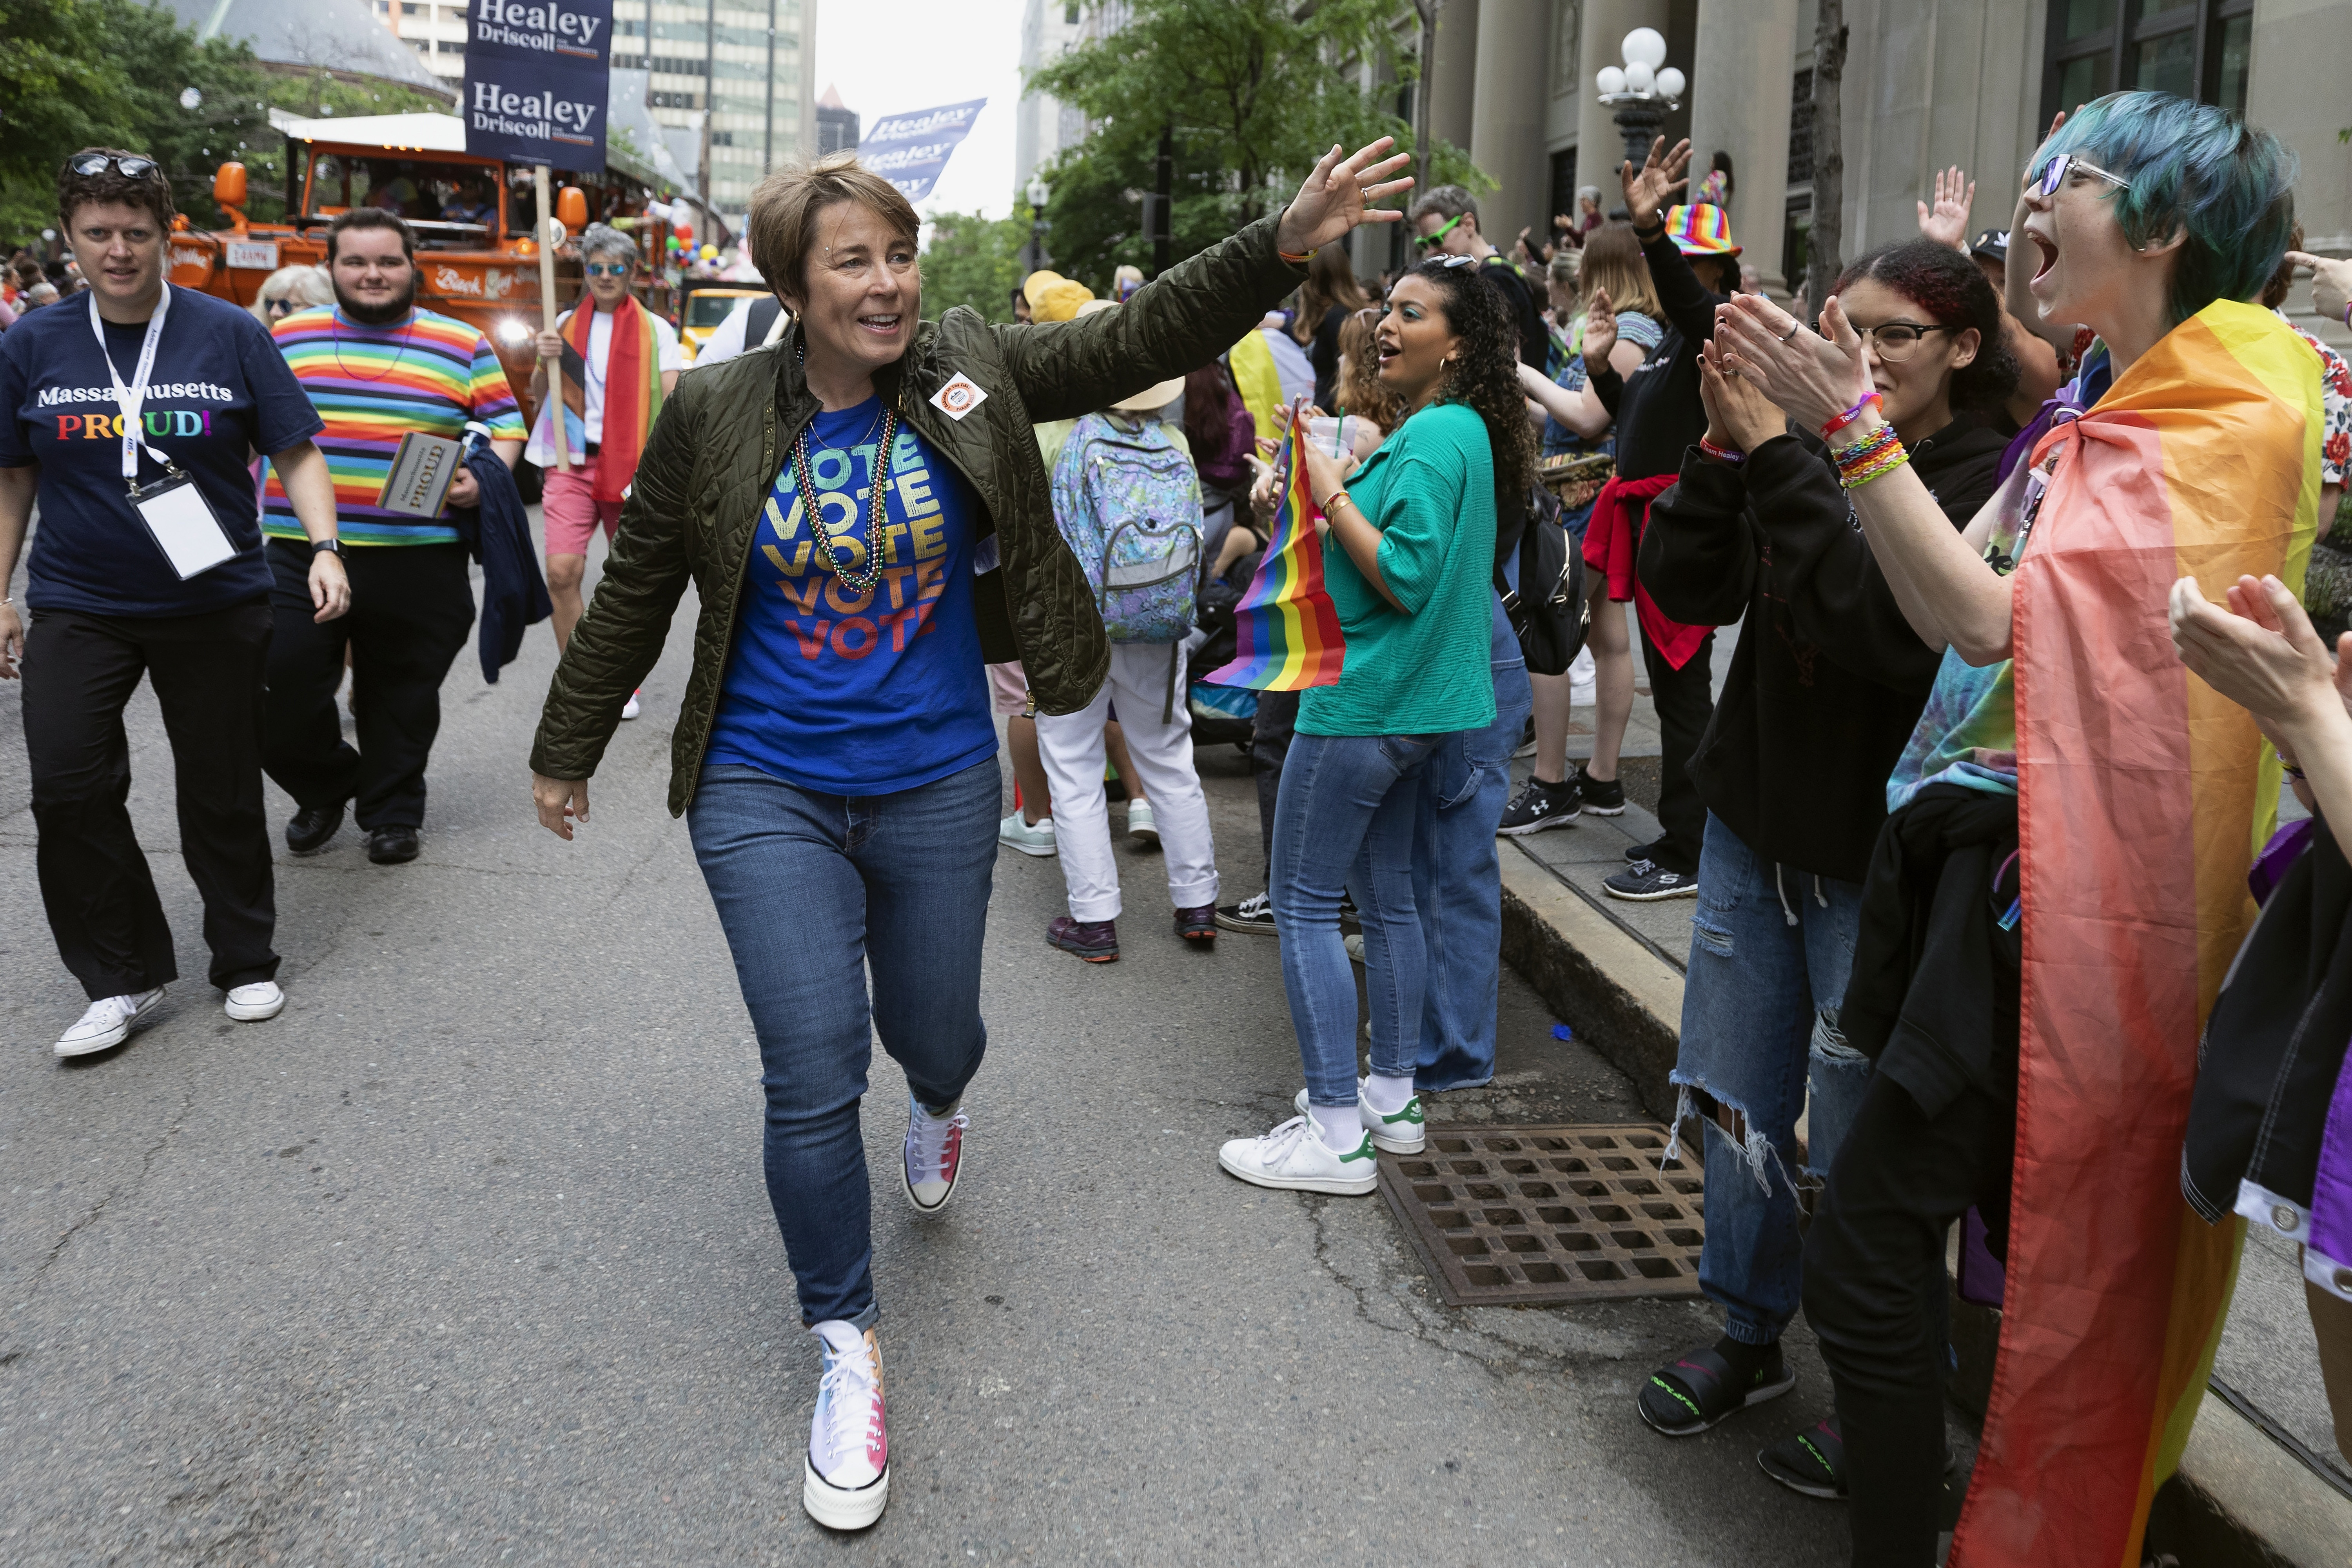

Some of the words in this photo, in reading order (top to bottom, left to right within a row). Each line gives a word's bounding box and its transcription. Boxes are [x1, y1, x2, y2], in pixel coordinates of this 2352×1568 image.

[477, 0, 602, 45] Healey
[477, 22, 556, 53] Driscoll
[473, 82, 597, 133] Healey
[473, 112, 552, 141] Driscoll
[877, 107, 975, 133] Healey
[37, 382, 233, 408] Massausetts
[56, 410, 212, 440] PROUD!
[1839, 409, 1860, 423] Team
[775, 432, 924, 494] VOTE
[1703, 444, 1717, 456] Team
[1718, 450, 1740, 461] Healey
[409, 444, 443, 508] PROUD
[762, 469, 941, 540] VOTE
[762, 513, 949, 577] VOTE
[777, 556, 946, 616] VOTE
